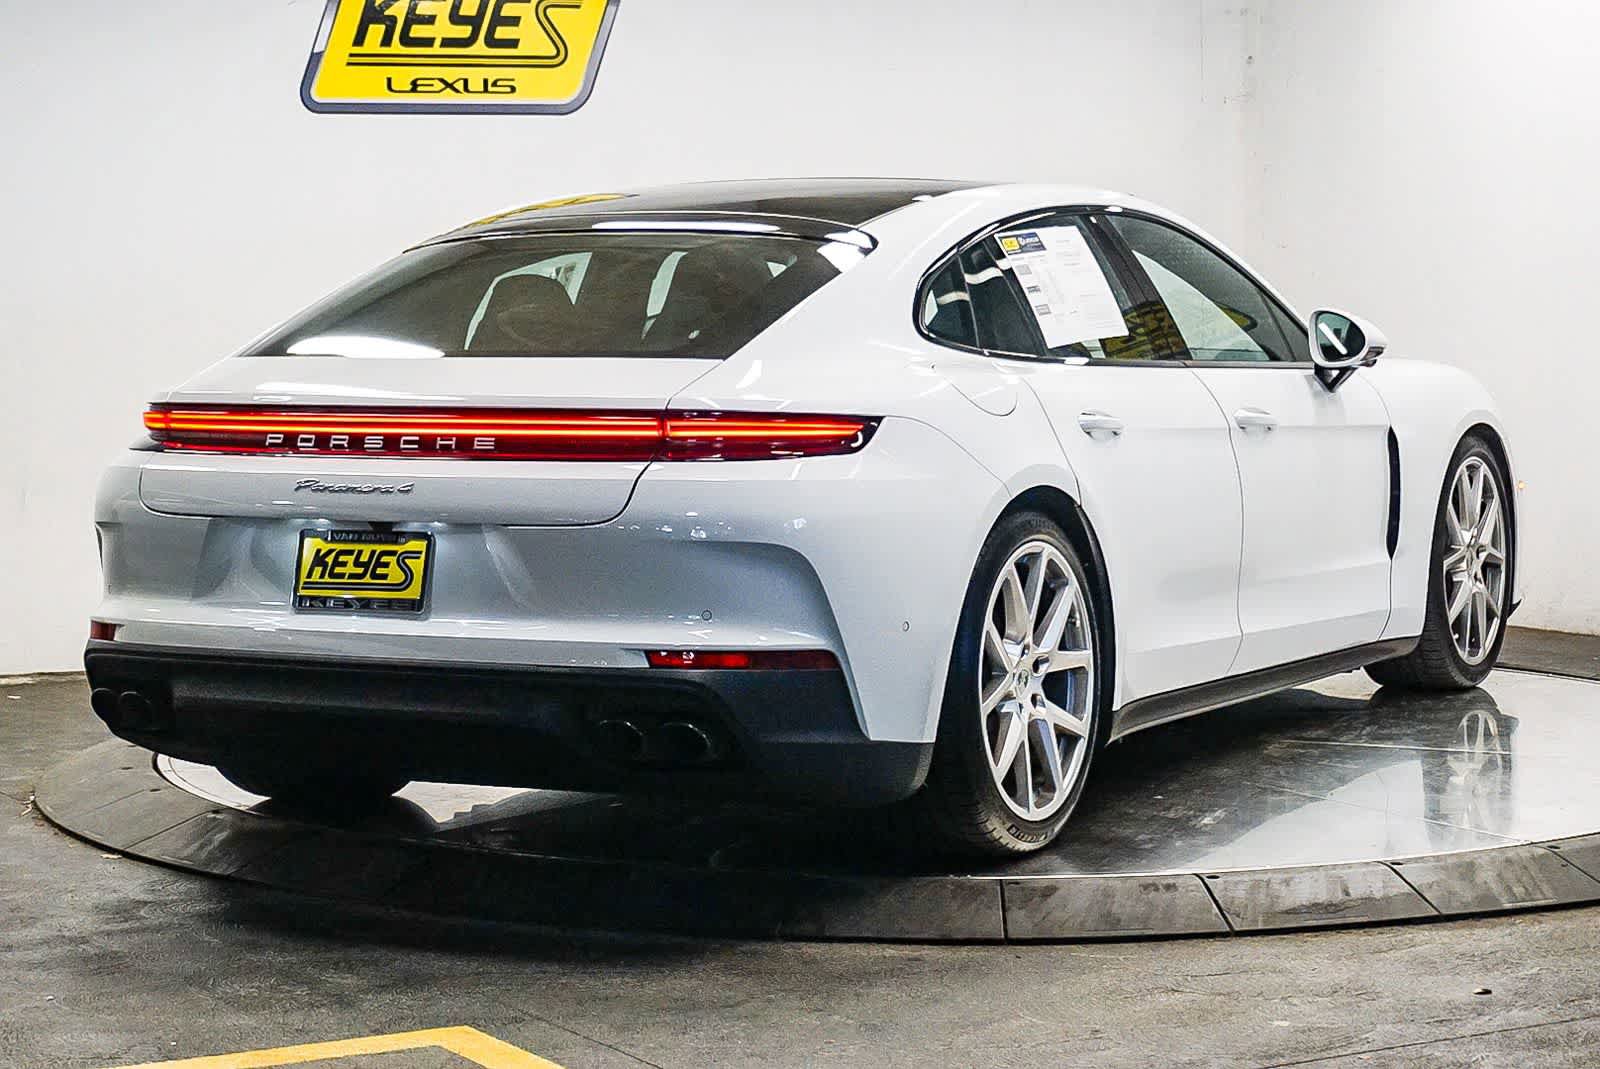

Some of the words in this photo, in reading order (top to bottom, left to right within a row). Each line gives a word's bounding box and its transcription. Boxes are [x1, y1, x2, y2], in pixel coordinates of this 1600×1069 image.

[346, 0, 582, 67] KEYES
[386, 77, 517, 94] LEXUS
[265, 433, 496, 450] PORSCHE
[294, 478, 394, 493] Panamera
[302, 549, 423, 592] KEYES
